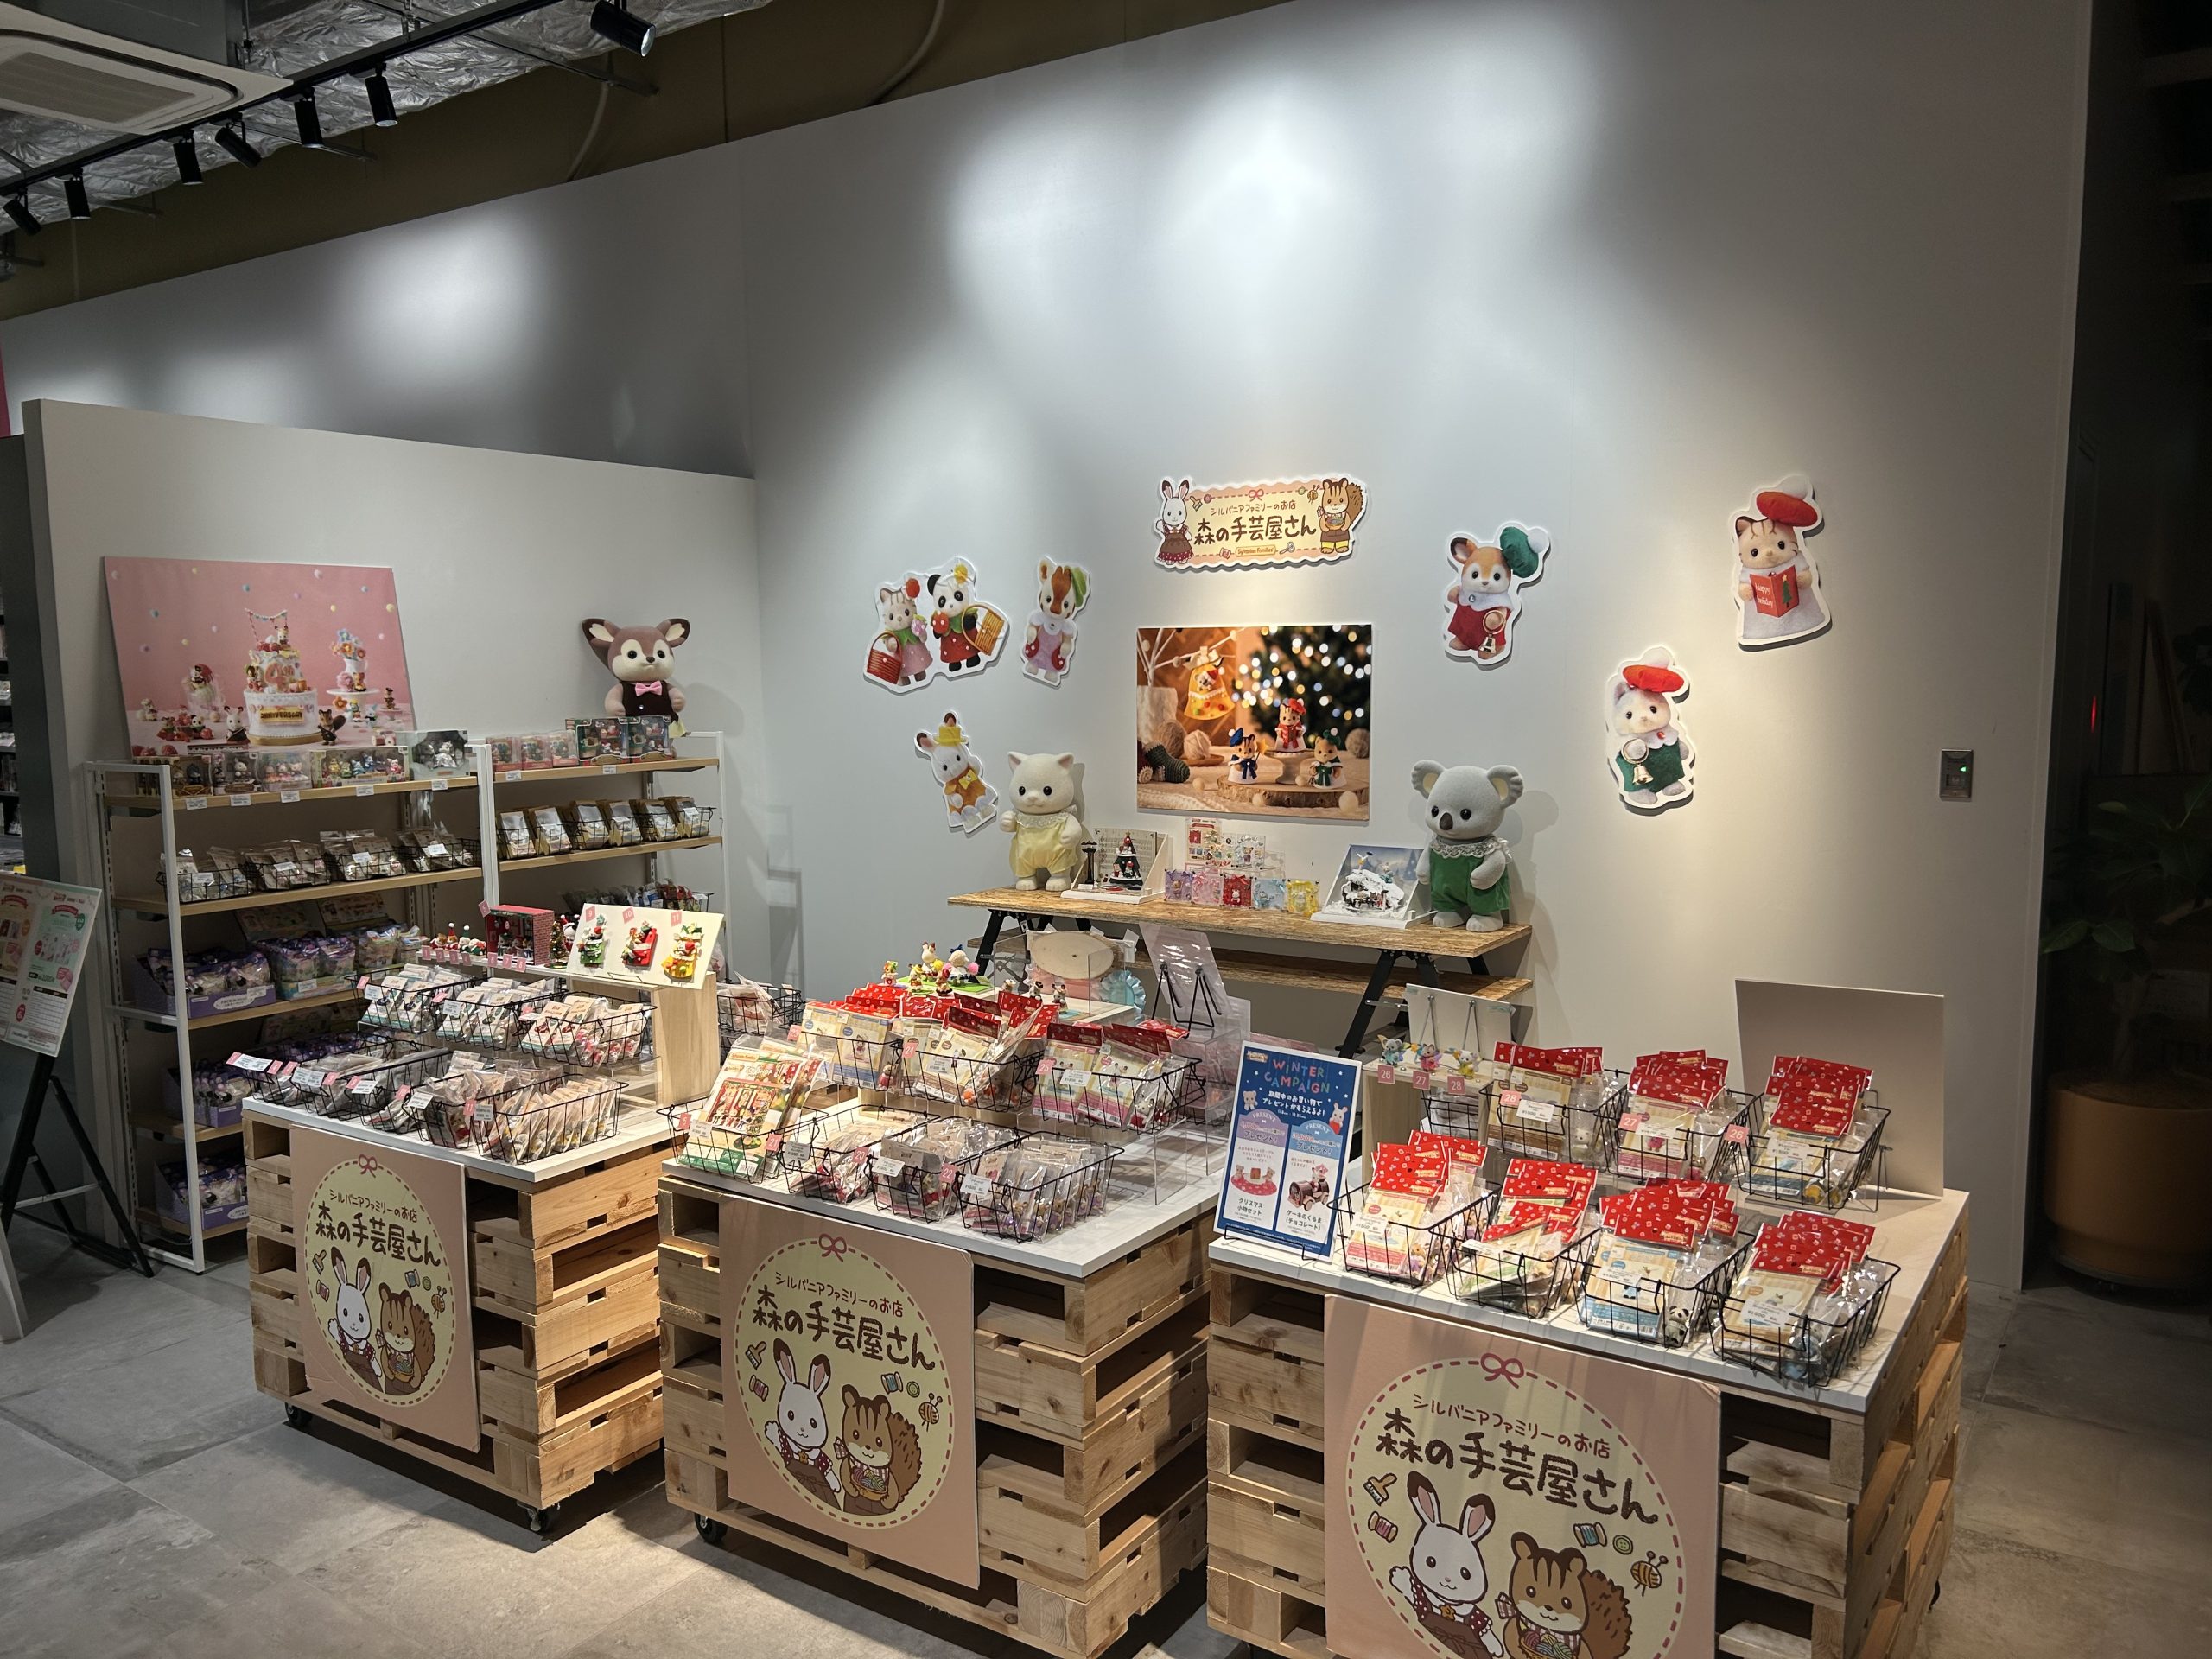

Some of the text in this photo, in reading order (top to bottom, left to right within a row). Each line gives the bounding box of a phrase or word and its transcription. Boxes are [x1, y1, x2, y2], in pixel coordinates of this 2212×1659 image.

[1210, 499, 1296, 517] シルバニアファミリーのお店
[1194, 515, 1317, 545] 森の手芸屋さん
[1754, 582, 1770, 595] Happy
[625, 910, 632, 918] 10
[673, 912, 680, 923] 11
[905, 1046, 914, 1054] 24
[1039, 1064, 1049, 1072] 25
[1273, 1059, 1325, 1078] WINTER
[1381, 1070, 1390, 1079] 26
[1264, 1071, 1331, 1094] CAMPAIGN
[1415, 1076, 1426, 1086] 27
[1451, 1081, 1461, 1090] 28
[1504, 1094, 1516, 1103] 28
[467, 1103, 474, 1112] 11
[1252, 1111, 1276, 1122] PRESENT
[1624, 1117, 1637, 1127] 27
[1306, 1124, 1331, 1135] PRESENT
[1729, 1129, 1742, 1140] 26
[769, 1138, 779, 1147] 21
[855, 1152, 864, 1160] 20
[942, 1169, 952, 1179] 22
[330, 1189, 418, 1223] シルバニアファミリーのお店
[1238, 1198, 1263, 1209] クリスマス
[1236, 1205, 1262, 1216] 小物セット
[1286, 1209, 1322, 1224] ケーキのくるま
[315, 1200, 441, 1267] 森の手芸屋さん
[775, 1272, 904, 1318] シルバニアファミリーのお店
[752, 1284, 936, 1370] 森の手芸屋さん
[1414, 1394, 1611, 1459] シルバニアファミリーのお店
[1376, 1408, 1659, 1524] 森の手芸屋さん
